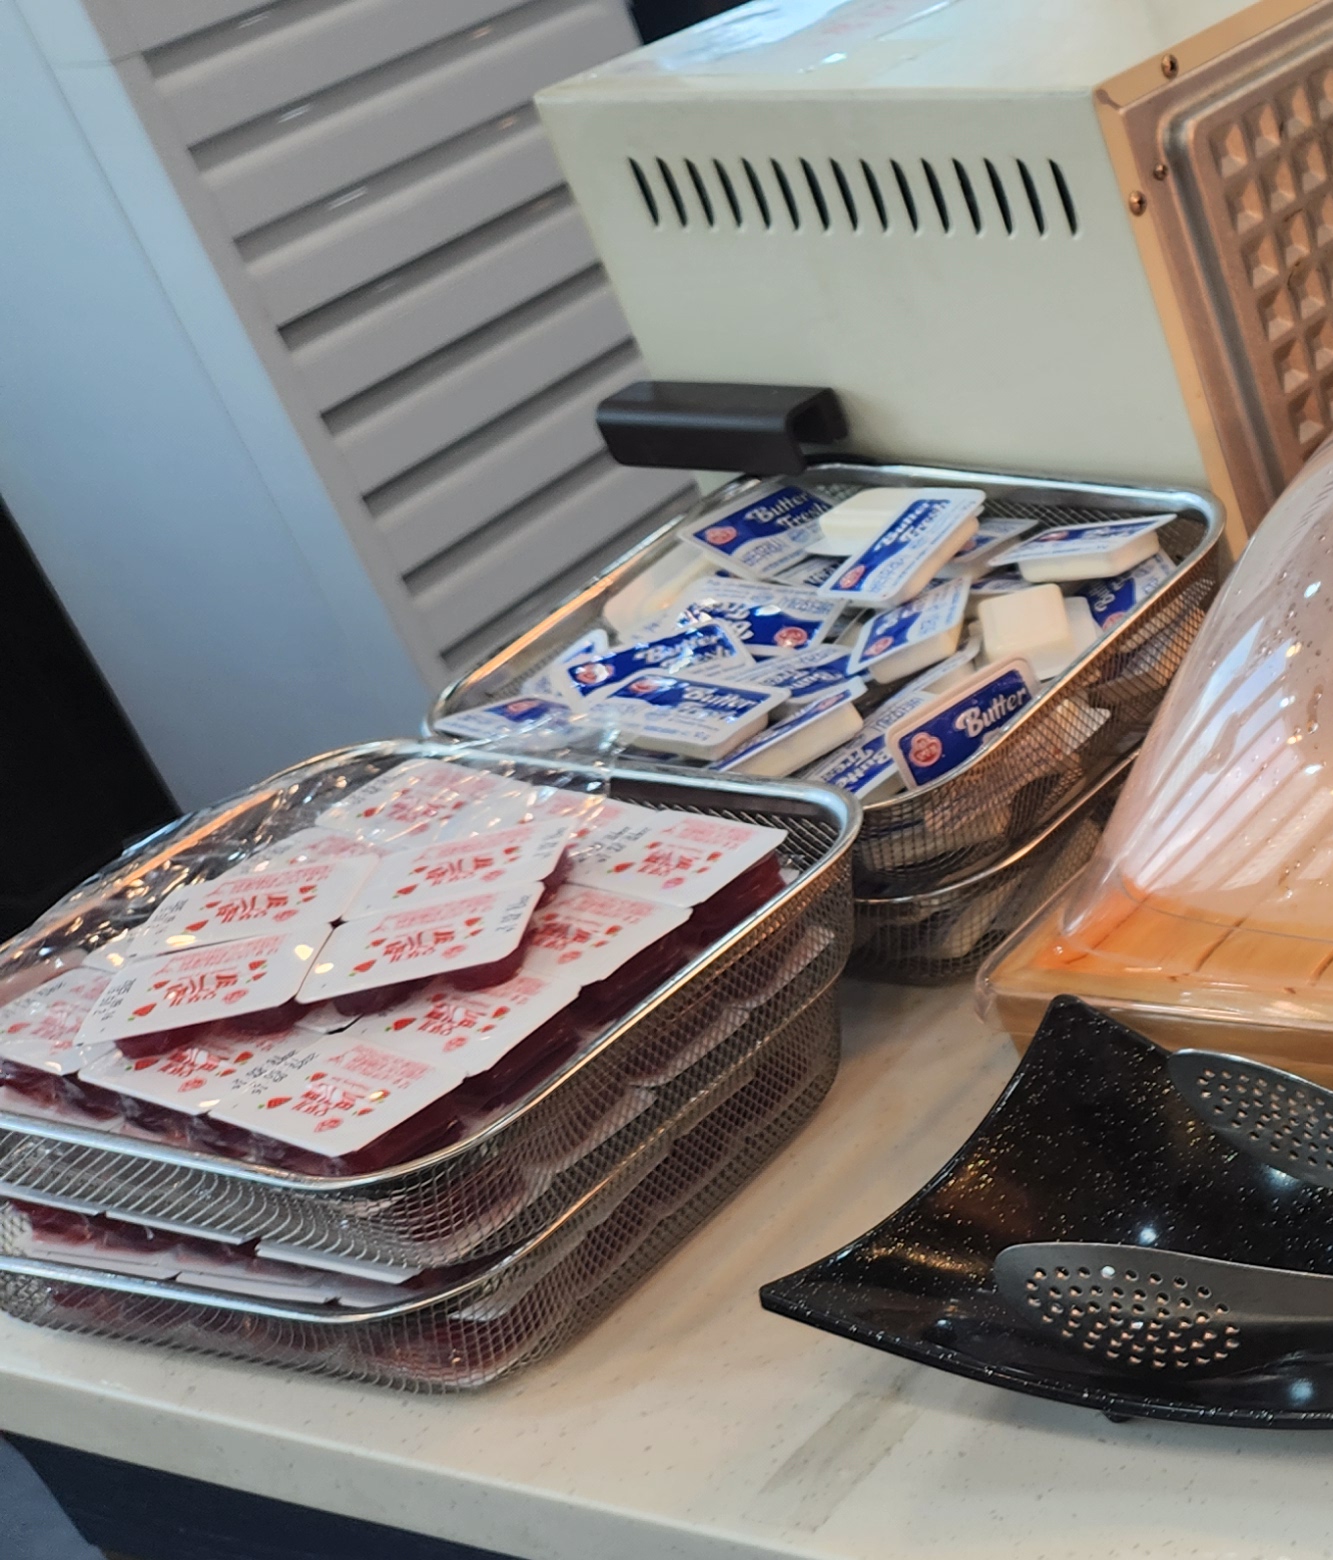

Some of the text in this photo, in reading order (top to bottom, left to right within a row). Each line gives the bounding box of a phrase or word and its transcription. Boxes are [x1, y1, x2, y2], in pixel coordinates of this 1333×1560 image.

[743, 491, 809, 523] Butter
[954, 687, 1027, 738] Butter
[834, 750, 893, 788] Butte
